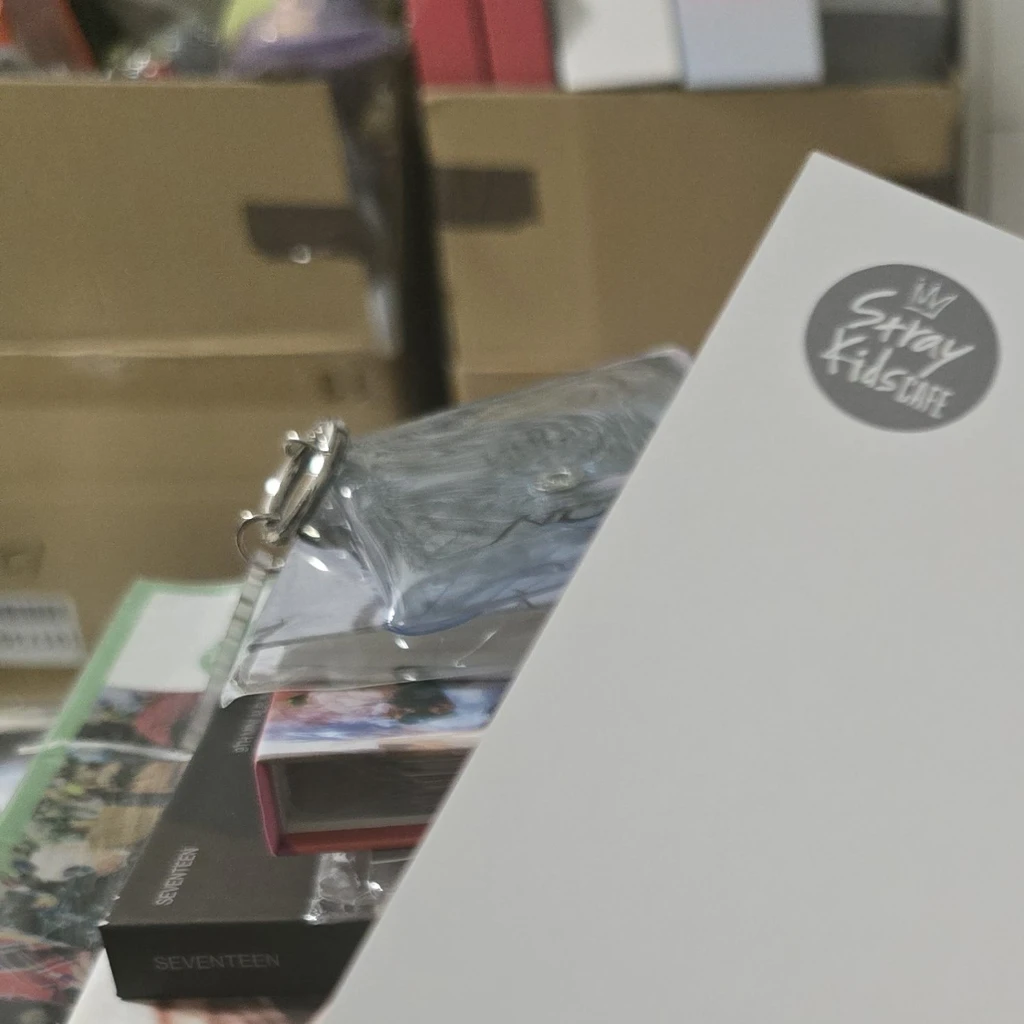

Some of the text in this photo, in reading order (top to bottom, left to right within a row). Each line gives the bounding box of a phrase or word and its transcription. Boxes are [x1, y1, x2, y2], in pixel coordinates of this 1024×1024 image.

[847, 290, 976, 378] Stray
[820, 327, 955, 419] Kids CAFE
[155, 846, 199, 906] SEVENTEEN
[154, 953, 281, 971] SEVENTEEN
